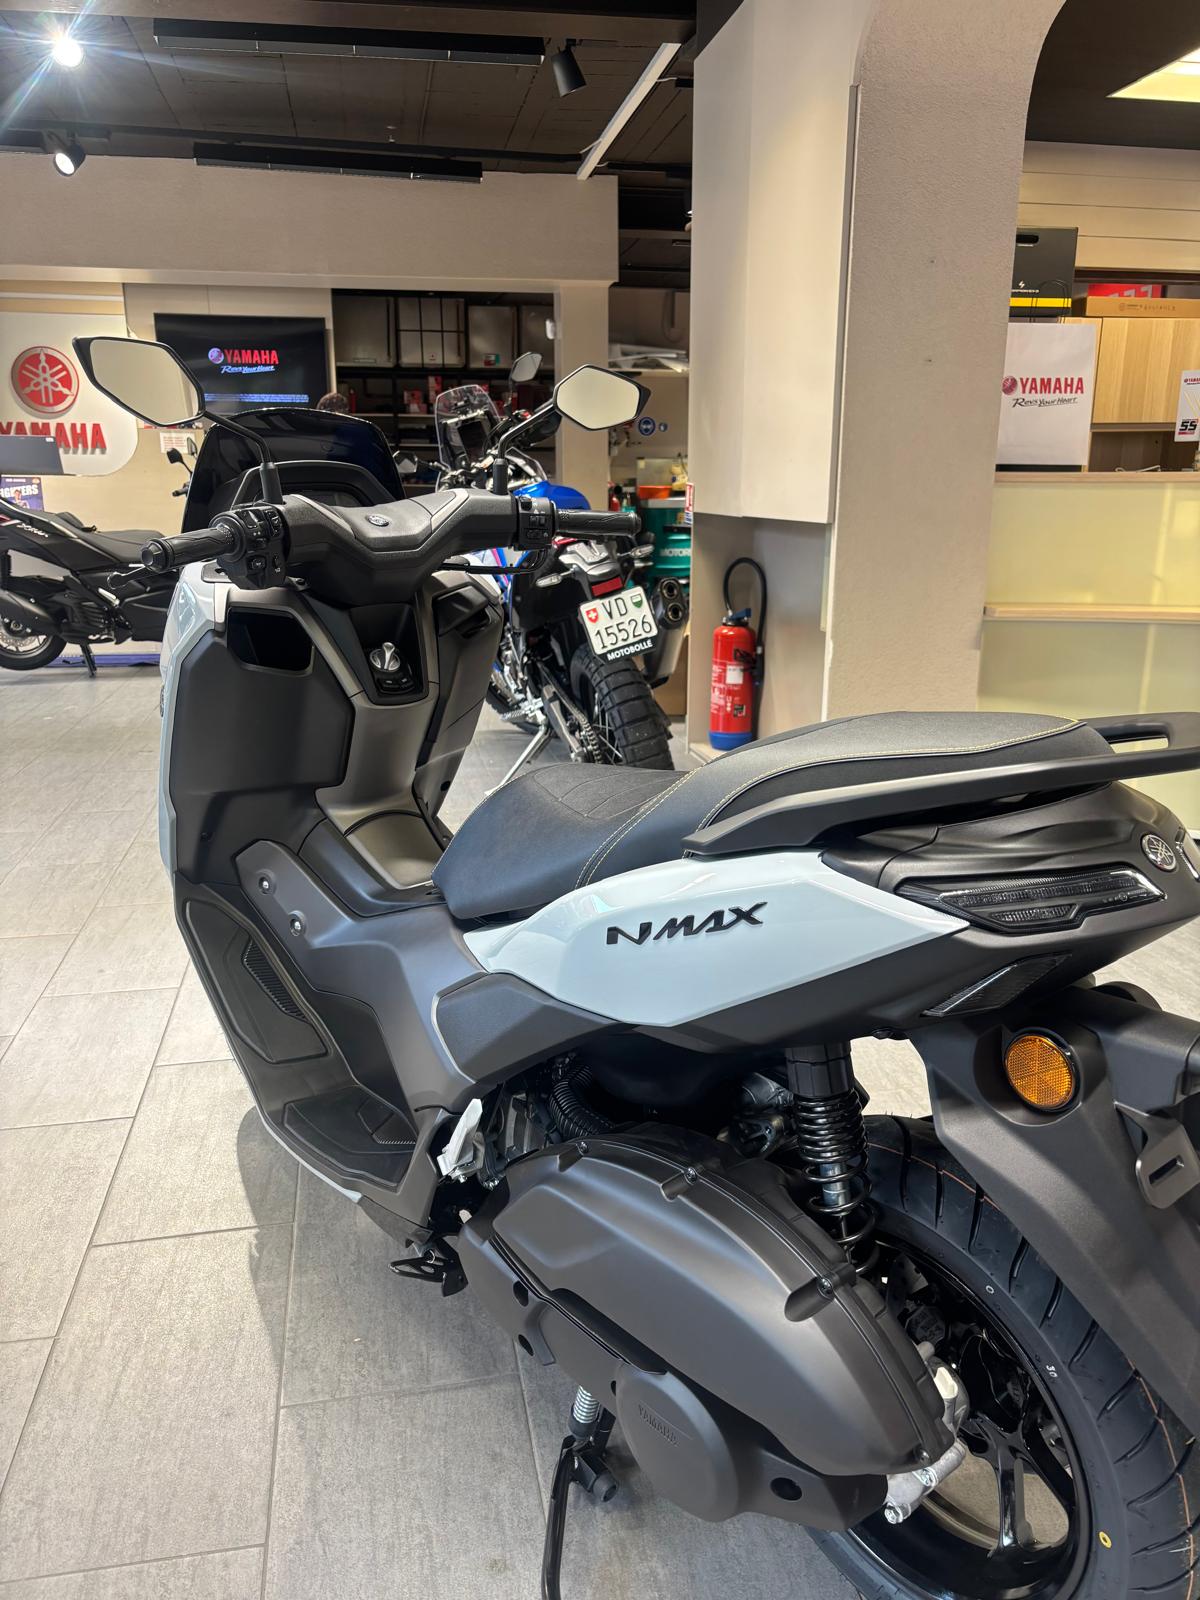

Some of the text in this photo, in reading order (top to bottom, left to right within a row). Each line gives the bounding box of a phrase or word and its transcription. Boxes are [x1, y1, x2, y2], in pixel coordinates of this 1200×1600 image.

[223, 349, 279, 365] YAMAHA
[1020, 377, 1084, 394] YAMAHA
[601, 597, 628, 620] VD
[595, 614, 652, 650] 15526
[606, 639, 653, 661] MOTOBOLLE
[606, 901, 768, 946] NMAX
